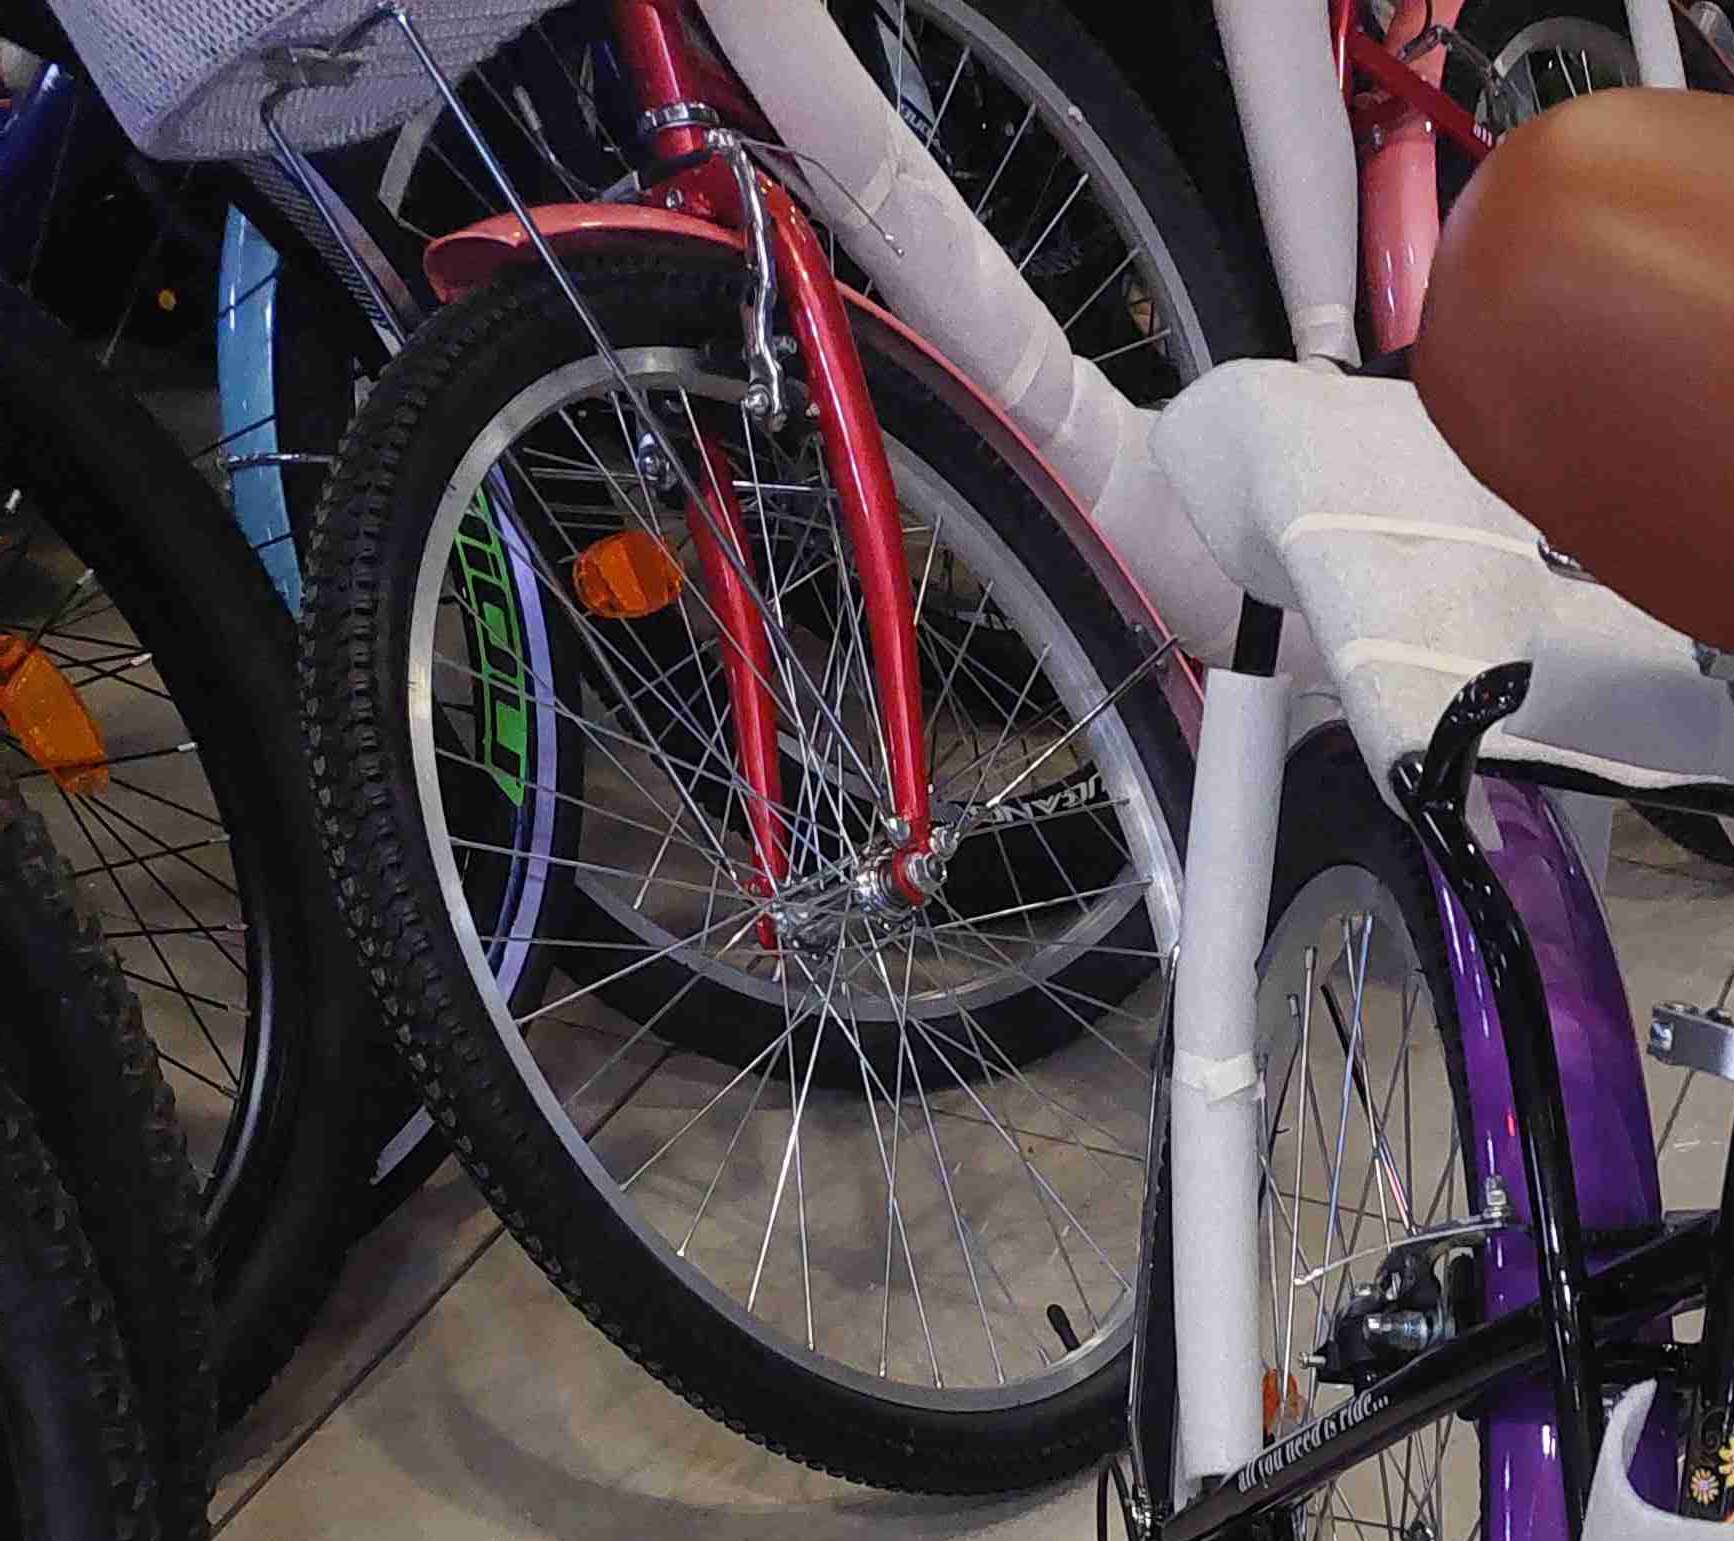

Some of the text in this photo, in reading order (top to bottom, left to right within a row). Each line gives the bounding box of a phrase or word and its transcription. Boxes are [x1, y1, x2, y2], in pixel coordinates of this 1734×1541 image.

[1237, 1460, 1258, 1494] all
[1257, 1446, 1284, 1489] you
[1285, 1417, 1323, 1465] need
[1323, 1414, 1338, 1442] is
